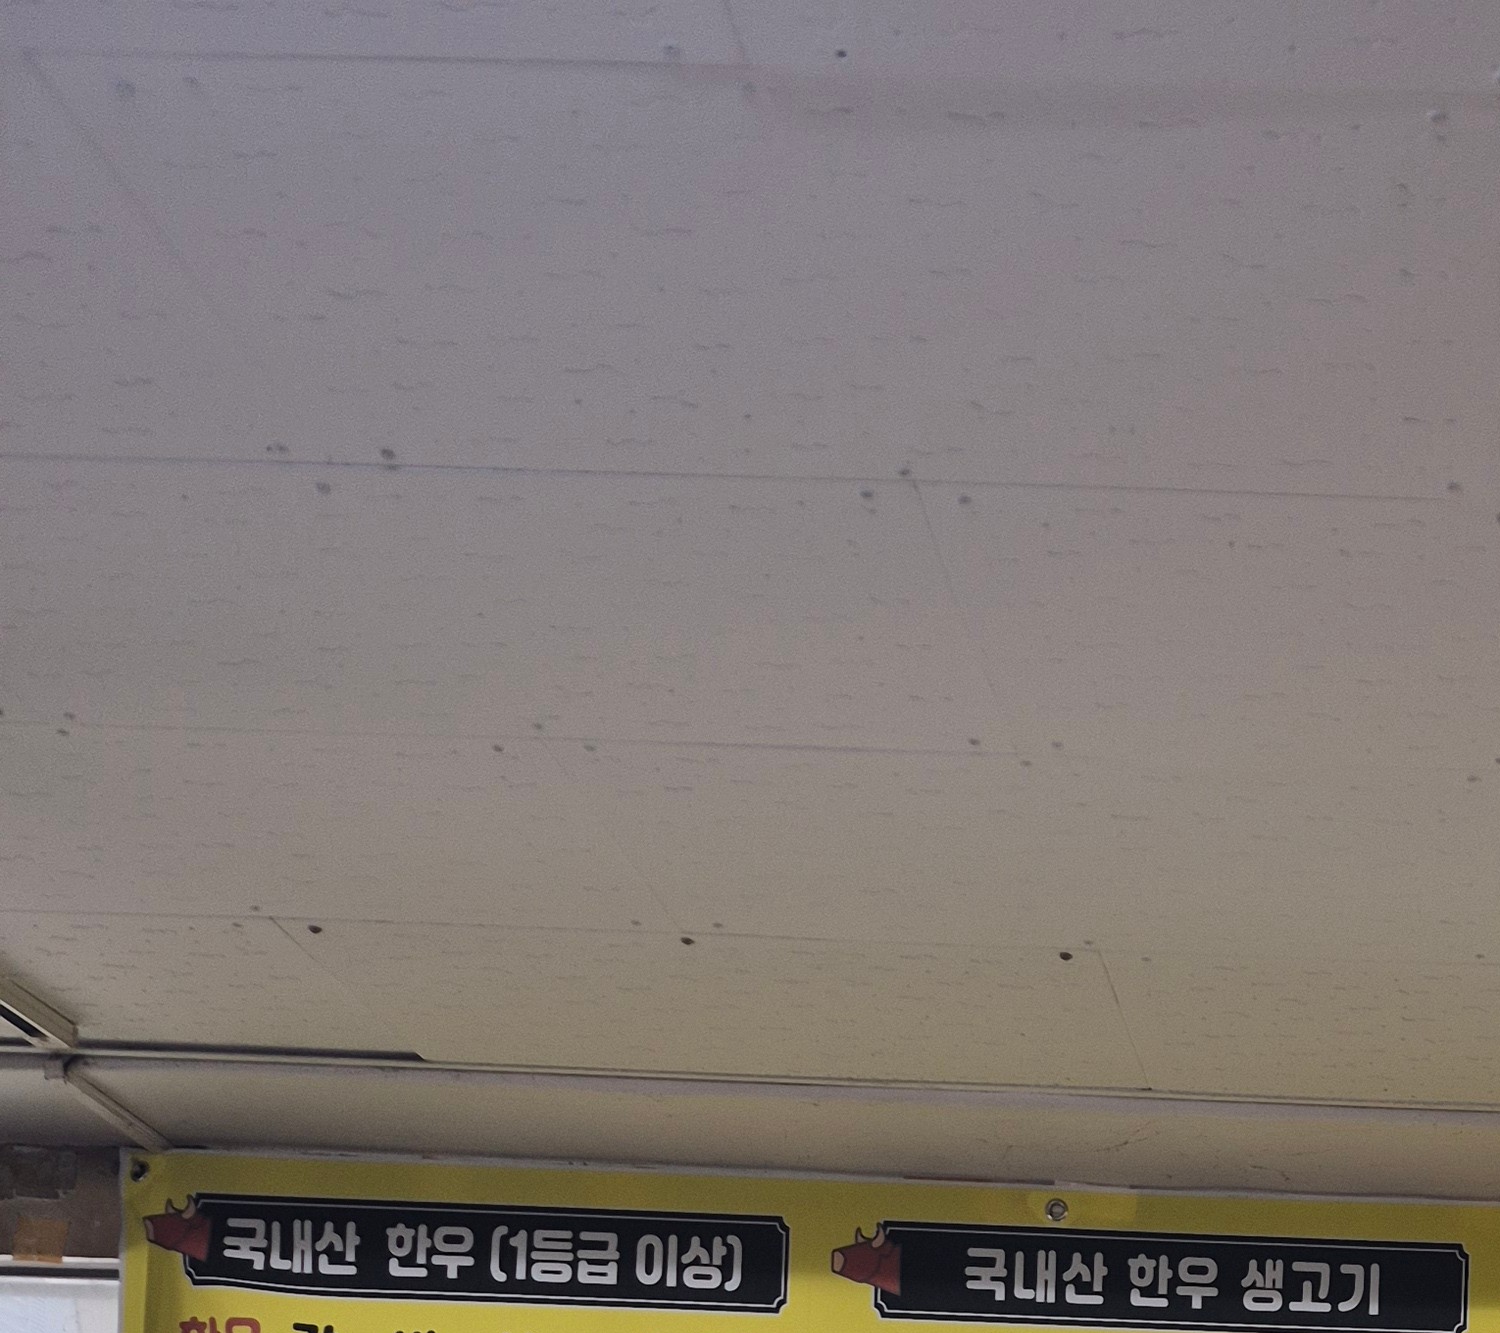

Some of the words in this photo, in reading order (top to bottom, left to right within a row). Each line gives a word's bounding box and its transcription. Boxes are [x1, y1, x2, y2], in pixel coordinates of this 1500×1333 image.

[222, 1218, 359, 1275] 국내산
[386, 1223, 475, 1279] 한우
[965, 1247, 1108, 1304] 국내산
[1128, 1254, 1218, 1309] 한우
[1241, 1260, 1381, 1316] 생고기
